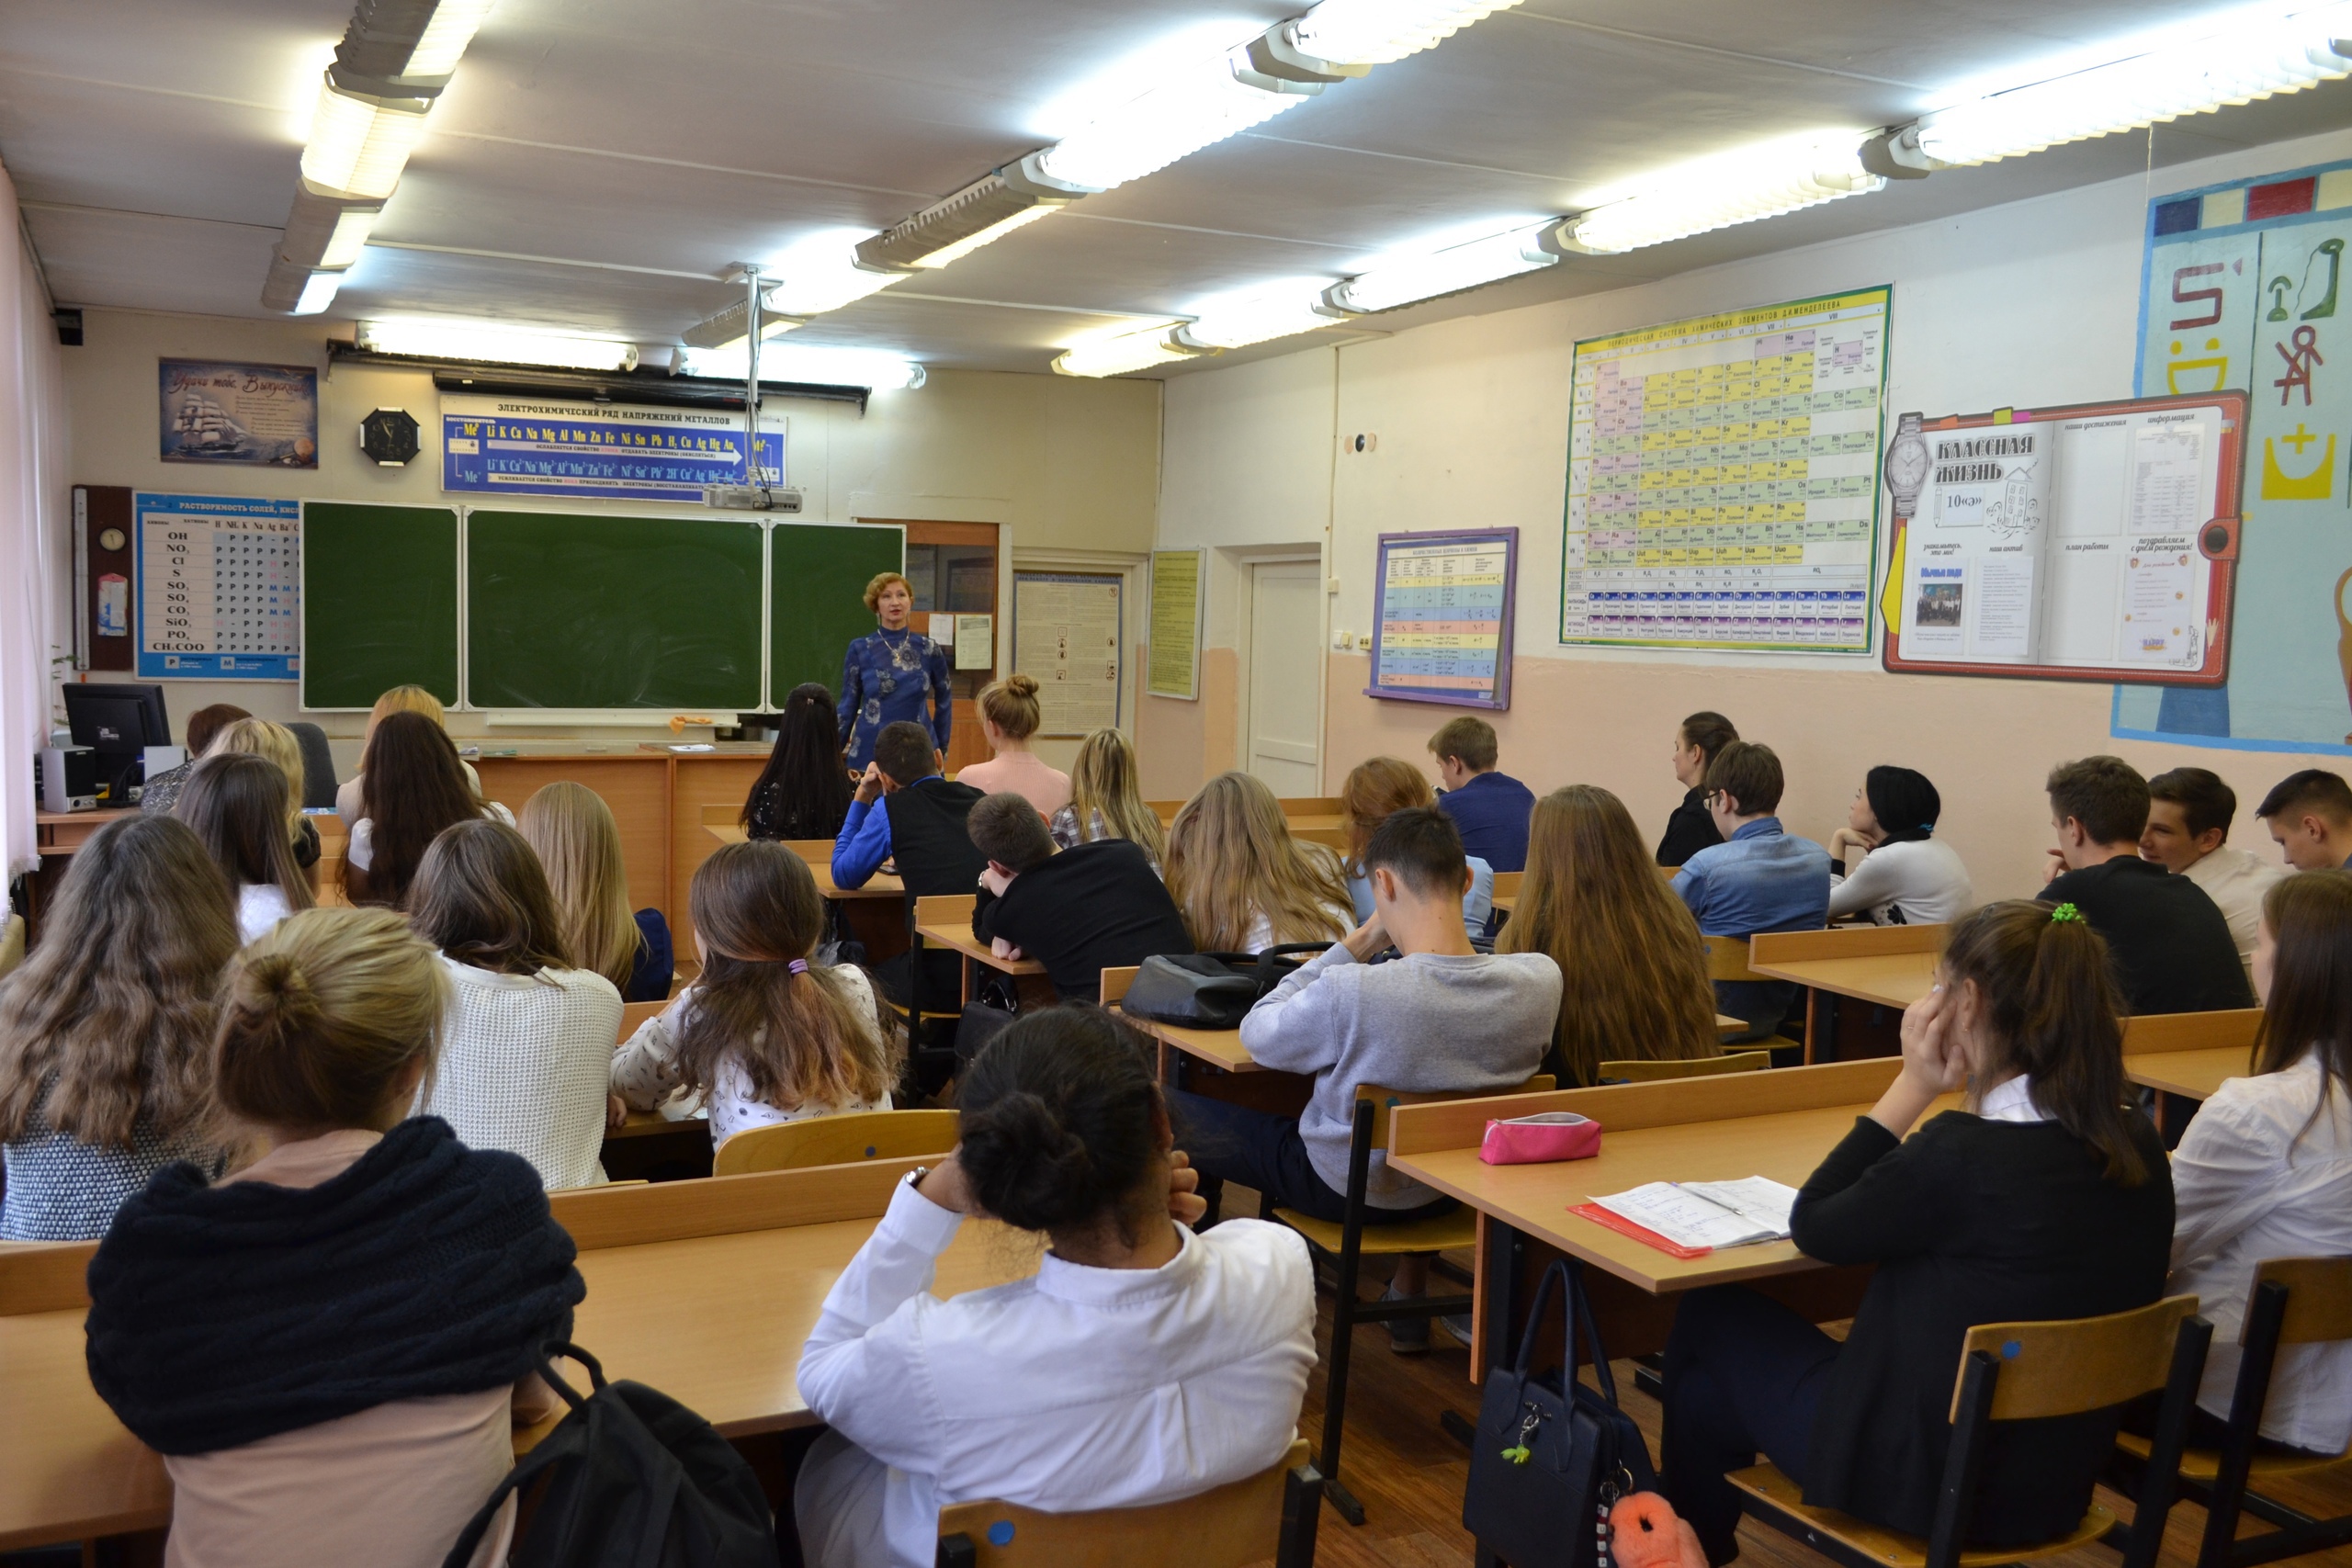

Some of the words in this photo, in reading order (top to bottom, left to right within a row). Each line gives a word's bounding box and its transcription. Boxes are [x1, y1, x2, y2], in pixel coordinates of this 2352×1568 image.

[1608, 333, 1654, 347] ПЕРИОДИЧЕСКАЯ
[1659, 327, 1686, 338] СИСТЕМА
[1692, 320, 1732, 332] ХИМИЧЕСКИХ
[1739, 312, 1778, 324] ЭЛЕМЕНТОВ
[498, 404, 600, 417] ЭЛЕКТРОХИМИЧЕСКИЙ
[602, 410, 619, 419] РЯД
[622, 411, 682, 422] НАПРЯЖЕНИЙ
[684, 415, 730, 425] МЕТАЛЛОВ
[2147, 414, 2195, 424] информация
[2084, 419, 2127, 430] достижения
[487, 426, 495, 437] Li
[500, 426, 507, 438] K
[510, 427, 521, 439] Ca
[526, 428, 538, 440] Na
[542, 428, 556, 442] Mg
[559, 429, 568, 441] Al
[573, 430, 586, 442] Mn
[590, 431, 601, 443] Zn
[605, 431, 615, 443] Fe
[622, 433, 630, 445] Ni
[635, 434, 646, 446] Sn
[651, 434, 662, 446] Pb
[681, 436, 691, 448] Cu
[696, 438, 706, 451] Ag
[710, 438, 720, 451] Hg
[724, 439, 734, 450] Au
[1937, 436, 2033, 459] КЛАССНАЯ
[1936, 463, 2002, 483] ЖИЗНЬ
[179, 502, 247, 512] РАСТВОРИМОСТЬ
[249, 505, 277, 514] СОЛЕЙ,
[2139, 536, 2185, 546] поздравляем
[2082, 543, 2109, 552] работы
[2154, 543, 2193, 553] рождения!
